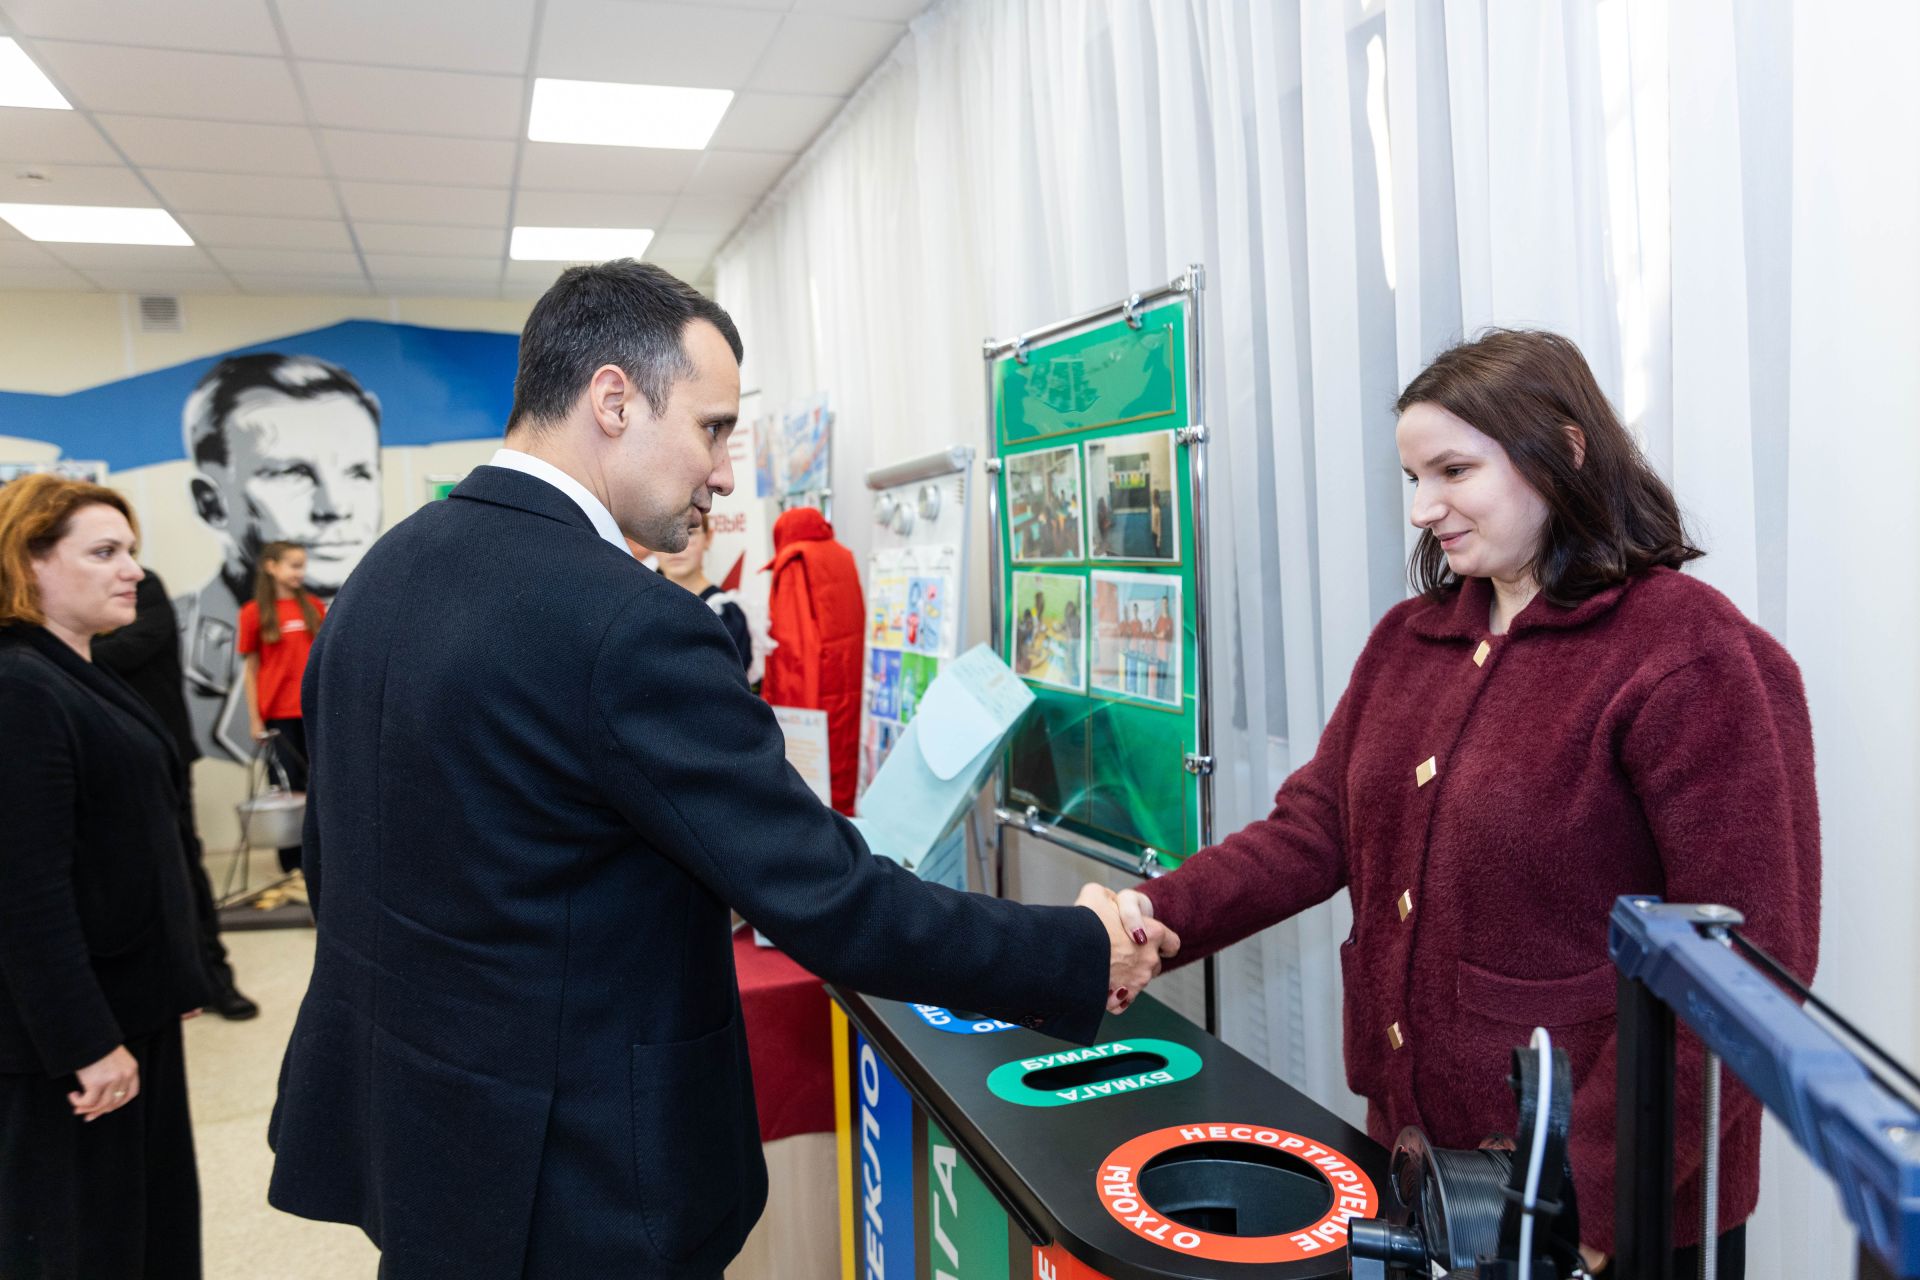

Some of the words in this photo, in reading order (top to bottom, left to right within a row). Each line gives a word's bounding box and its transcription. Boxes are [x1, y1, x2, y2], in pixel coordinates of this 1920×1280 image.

[1020, 1043, 1132, 1071] БУМАГА
[1056, 1071, 1173, 1101] БУМАГА
[861, 1044, 885, 1280] ЕКЛО
[1180, 1125, 1367, 1252] НЕСОРТИРУЕМЫЕ
[1103, 1165, 1201, 1249] ОТХОДЫ
